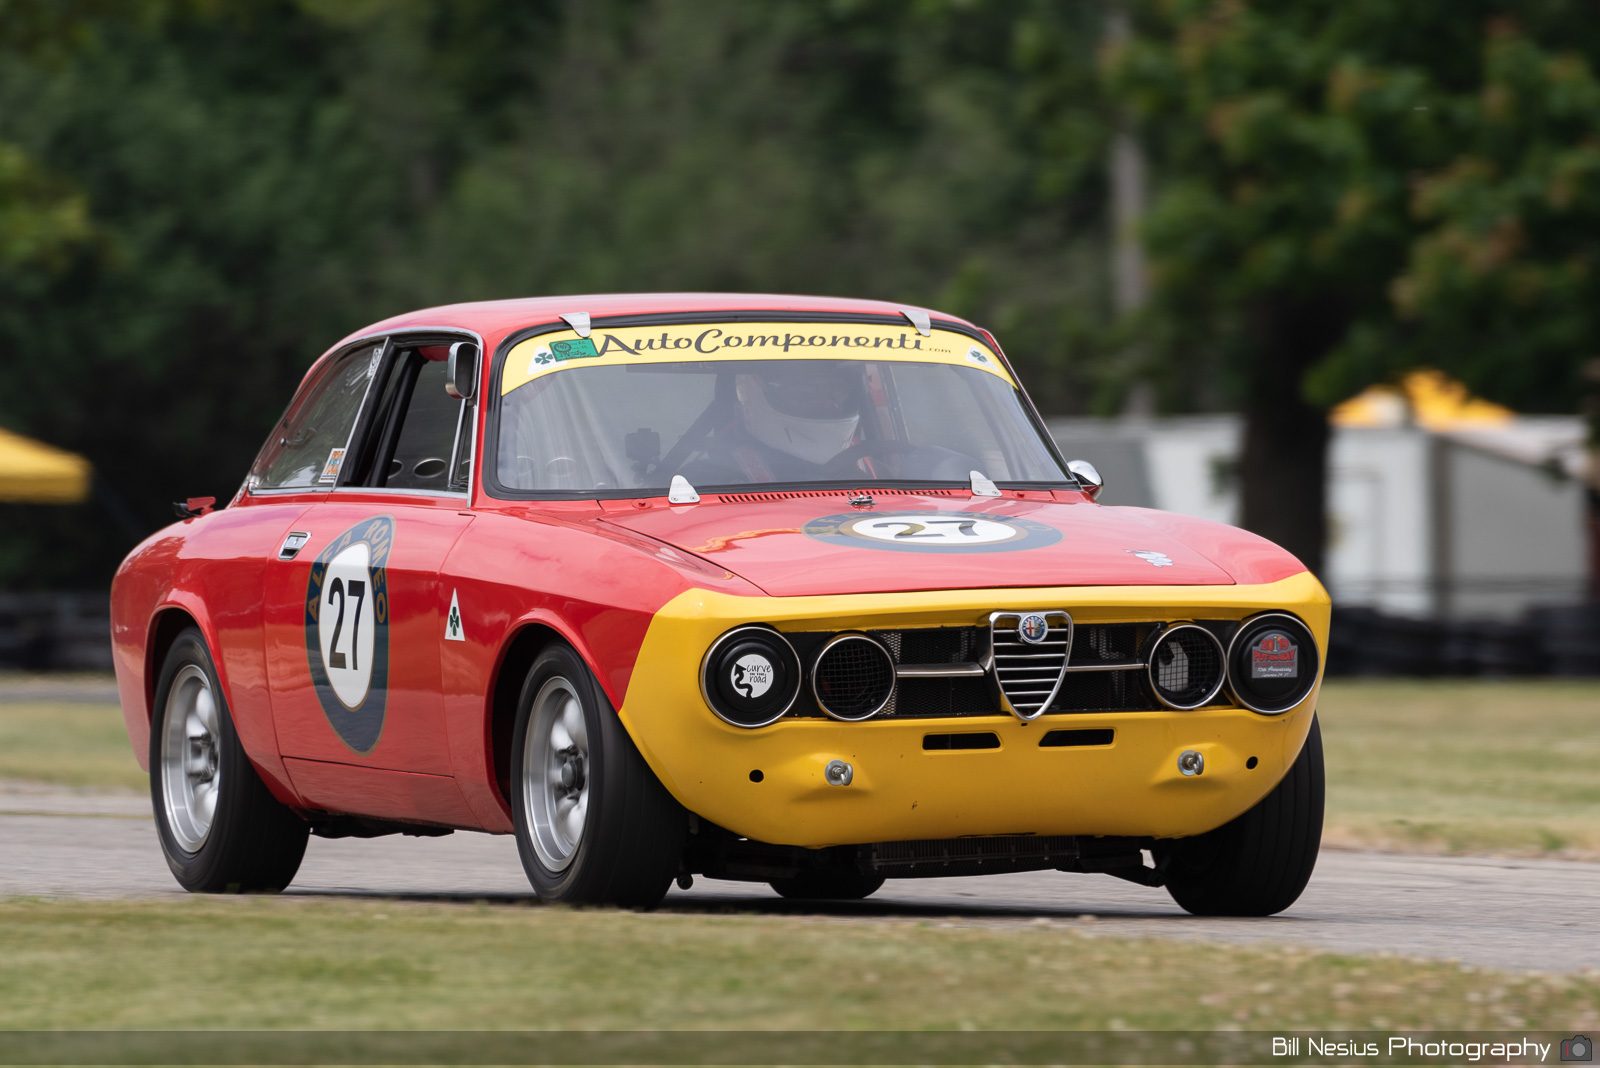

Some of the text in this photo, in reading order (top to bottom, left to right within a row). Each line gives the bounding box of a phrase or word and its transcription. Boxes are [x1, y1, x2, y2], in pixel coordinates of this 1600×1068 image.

[872, 519, 980, 539] 27
[307, 518, 390, 624] ALFA ROMEO
[328, 577, 365, 670] 27
[746, 664, 771, 673] curve
[749, 673, 767, 684] road
